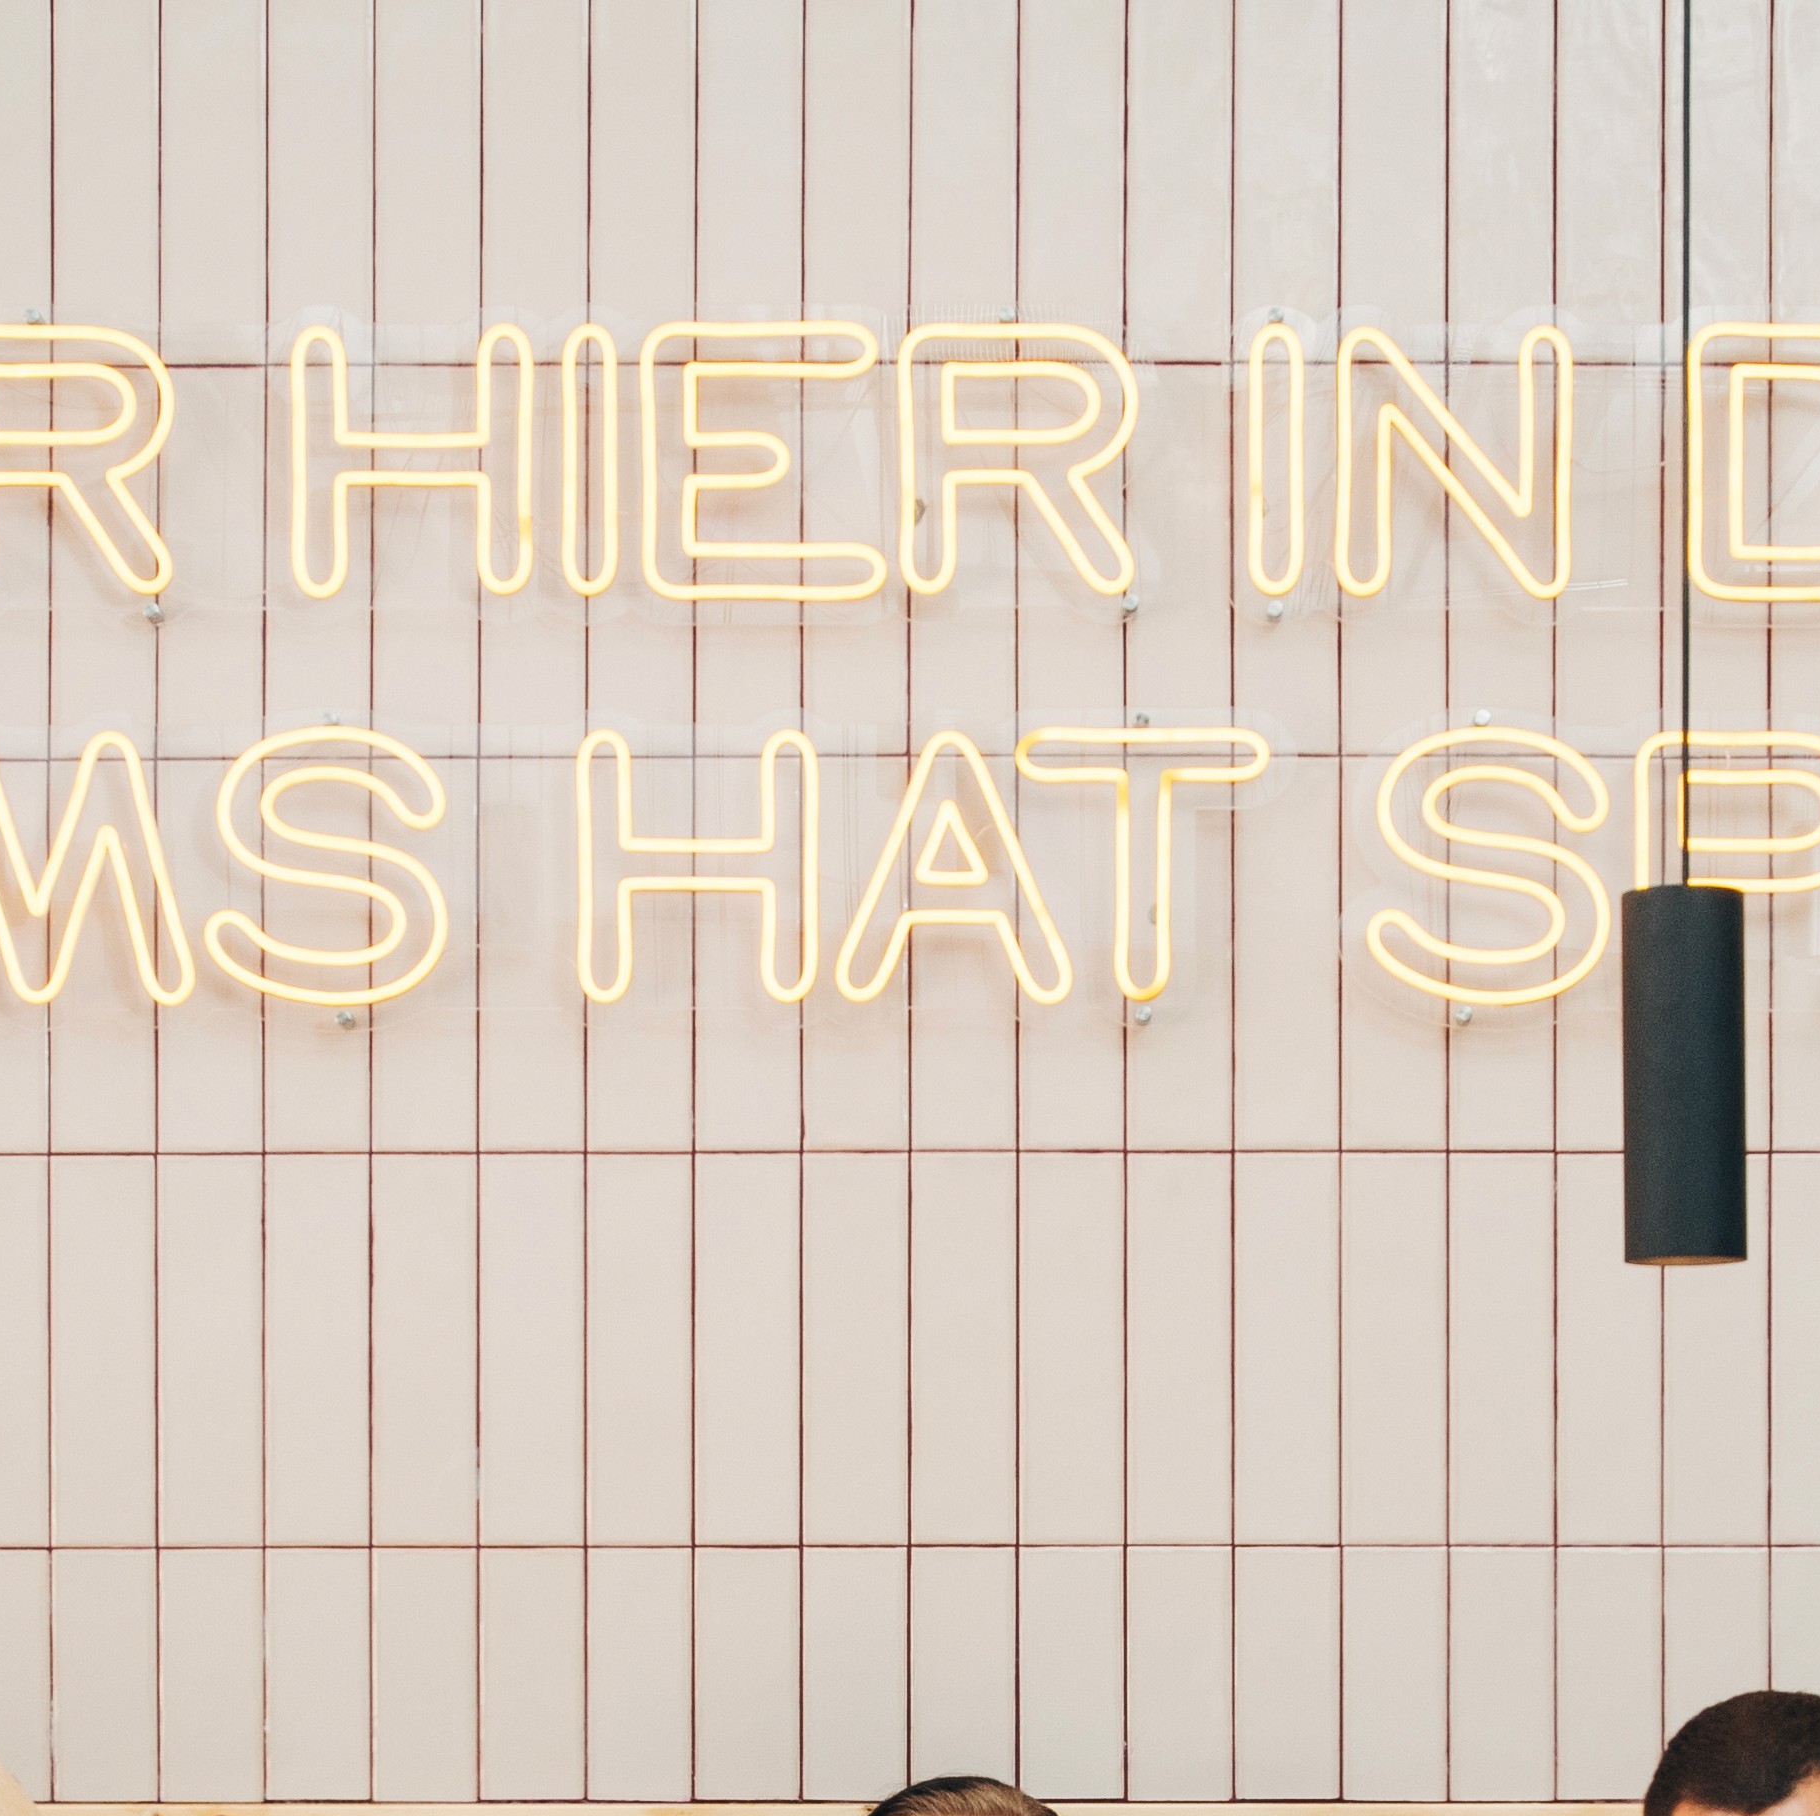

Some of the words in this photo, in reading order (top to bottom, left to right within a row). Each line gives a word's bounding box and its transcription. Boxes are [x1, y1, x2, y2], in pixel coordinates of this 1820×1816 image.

[291, 321, 1135, 602] HIER
[1247, 323, 1574, 601] IN
[576, 728, 1271, 1004] HAT
